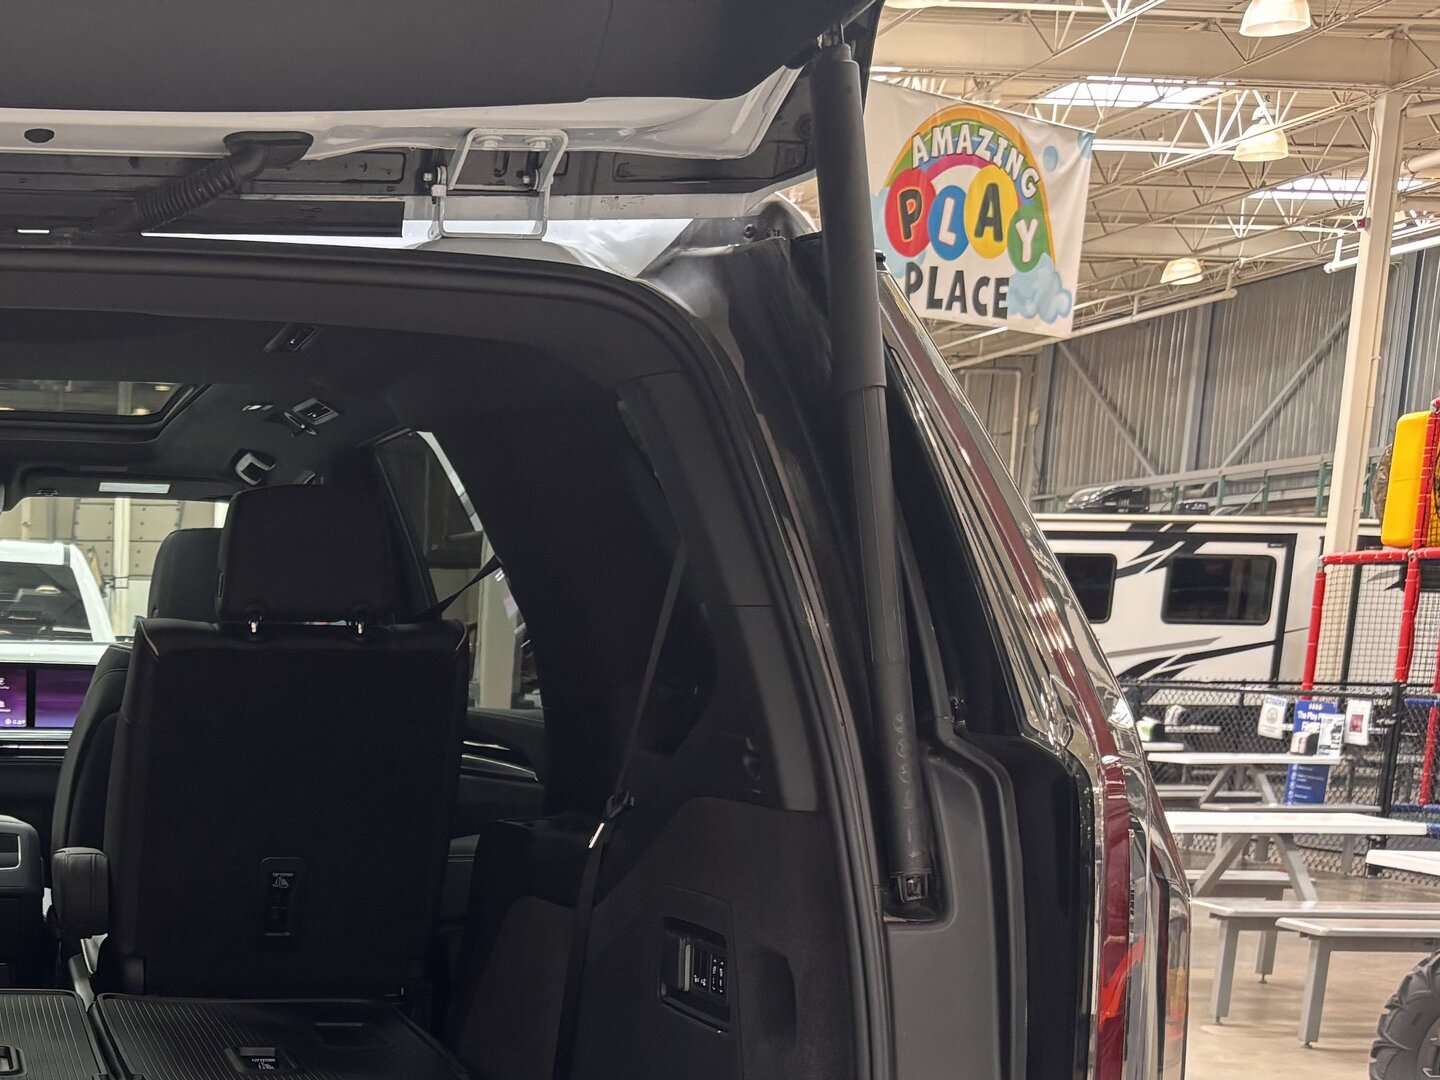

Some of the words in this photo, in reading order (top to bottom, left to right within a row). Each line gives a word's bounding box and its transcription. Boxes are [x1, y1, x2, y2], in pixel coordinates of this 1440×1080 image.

[911, 124, 1041, 200] AMAZING
[897, 182, 1039, 263] PLAY
[904, 261, 1010, 320] PLACE
